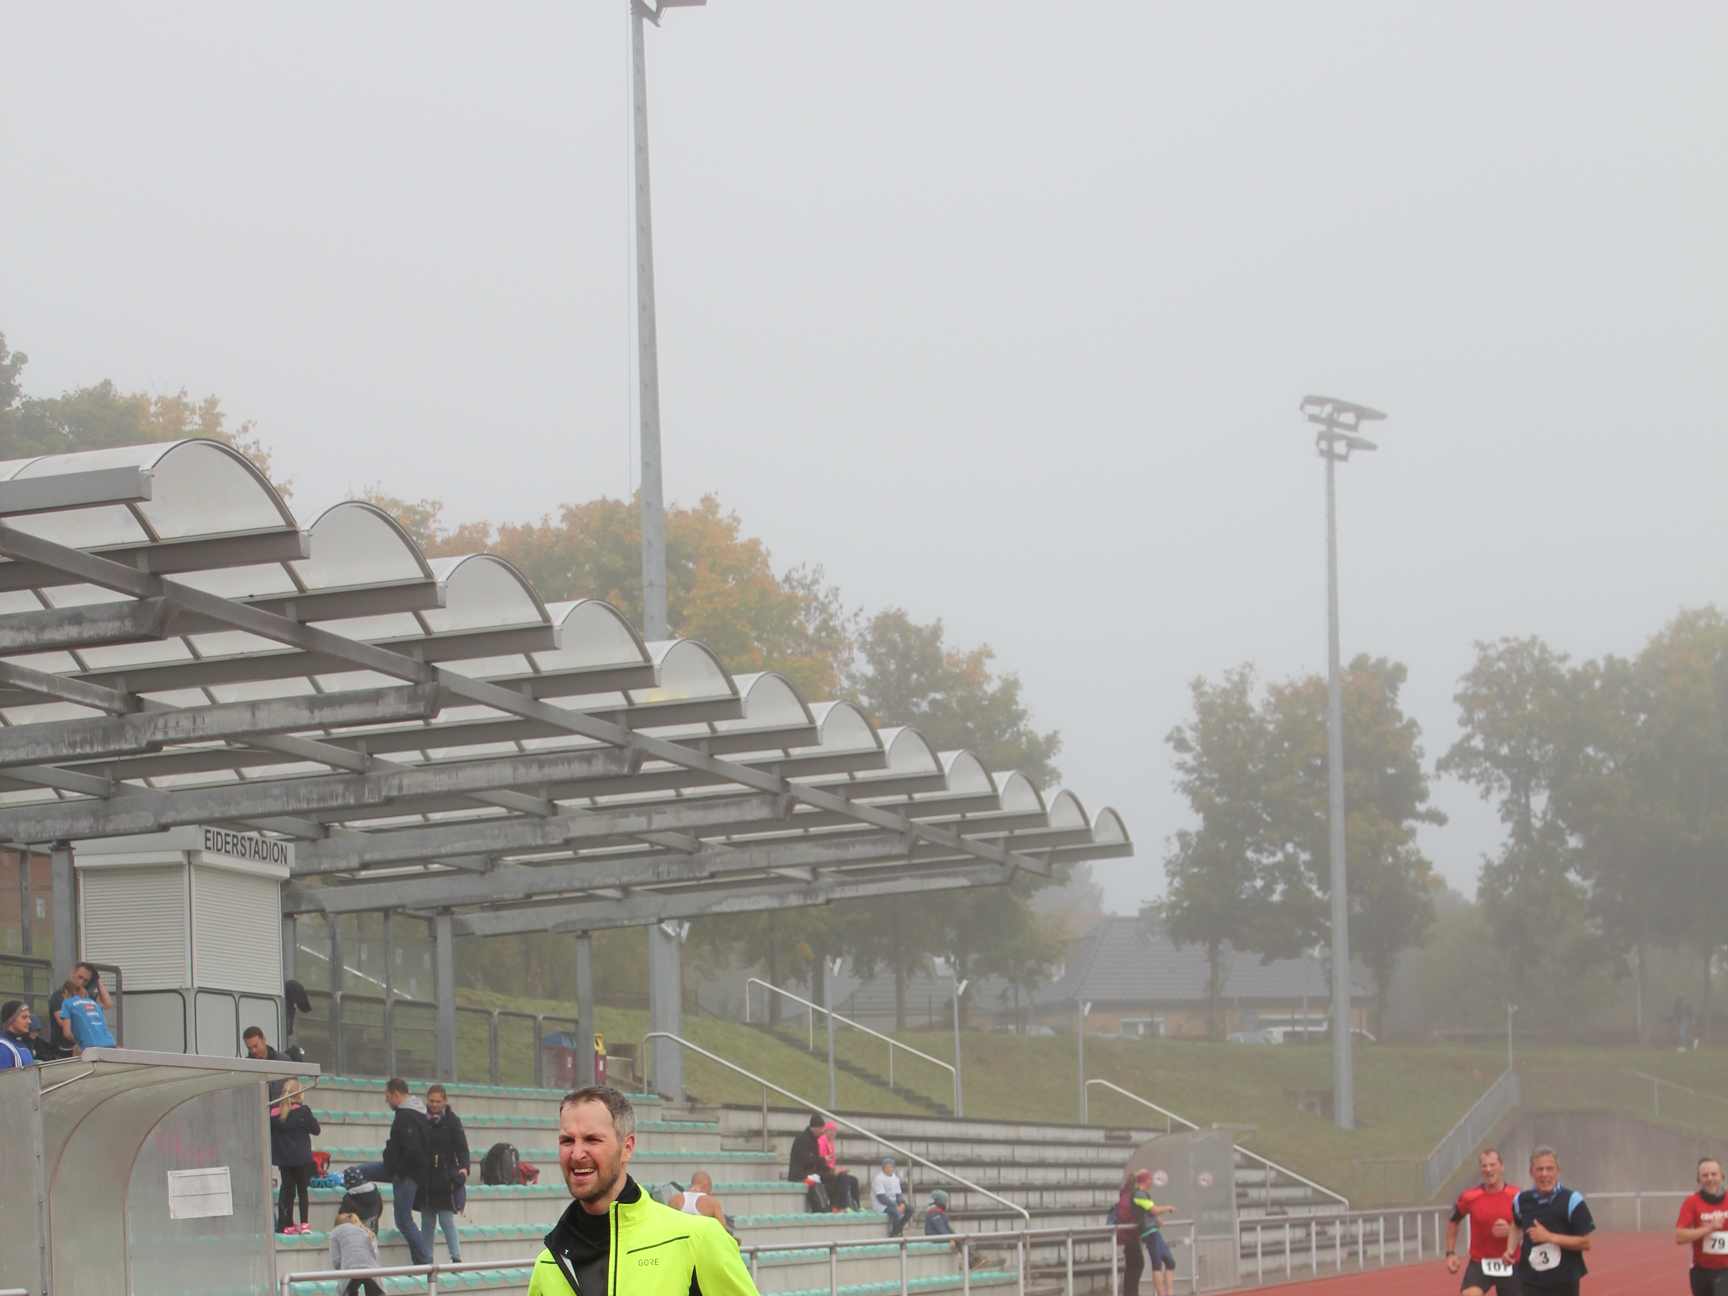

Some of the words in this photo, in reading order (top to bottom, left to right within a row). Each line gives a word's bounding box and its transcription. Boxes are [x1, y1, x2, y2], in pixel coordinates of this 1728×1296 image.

[204, 829, 288, 865] EIDERSTADION
[637, 1258, 660, 1267] GORE
[1539, 1250, 1550, 1265] 3
